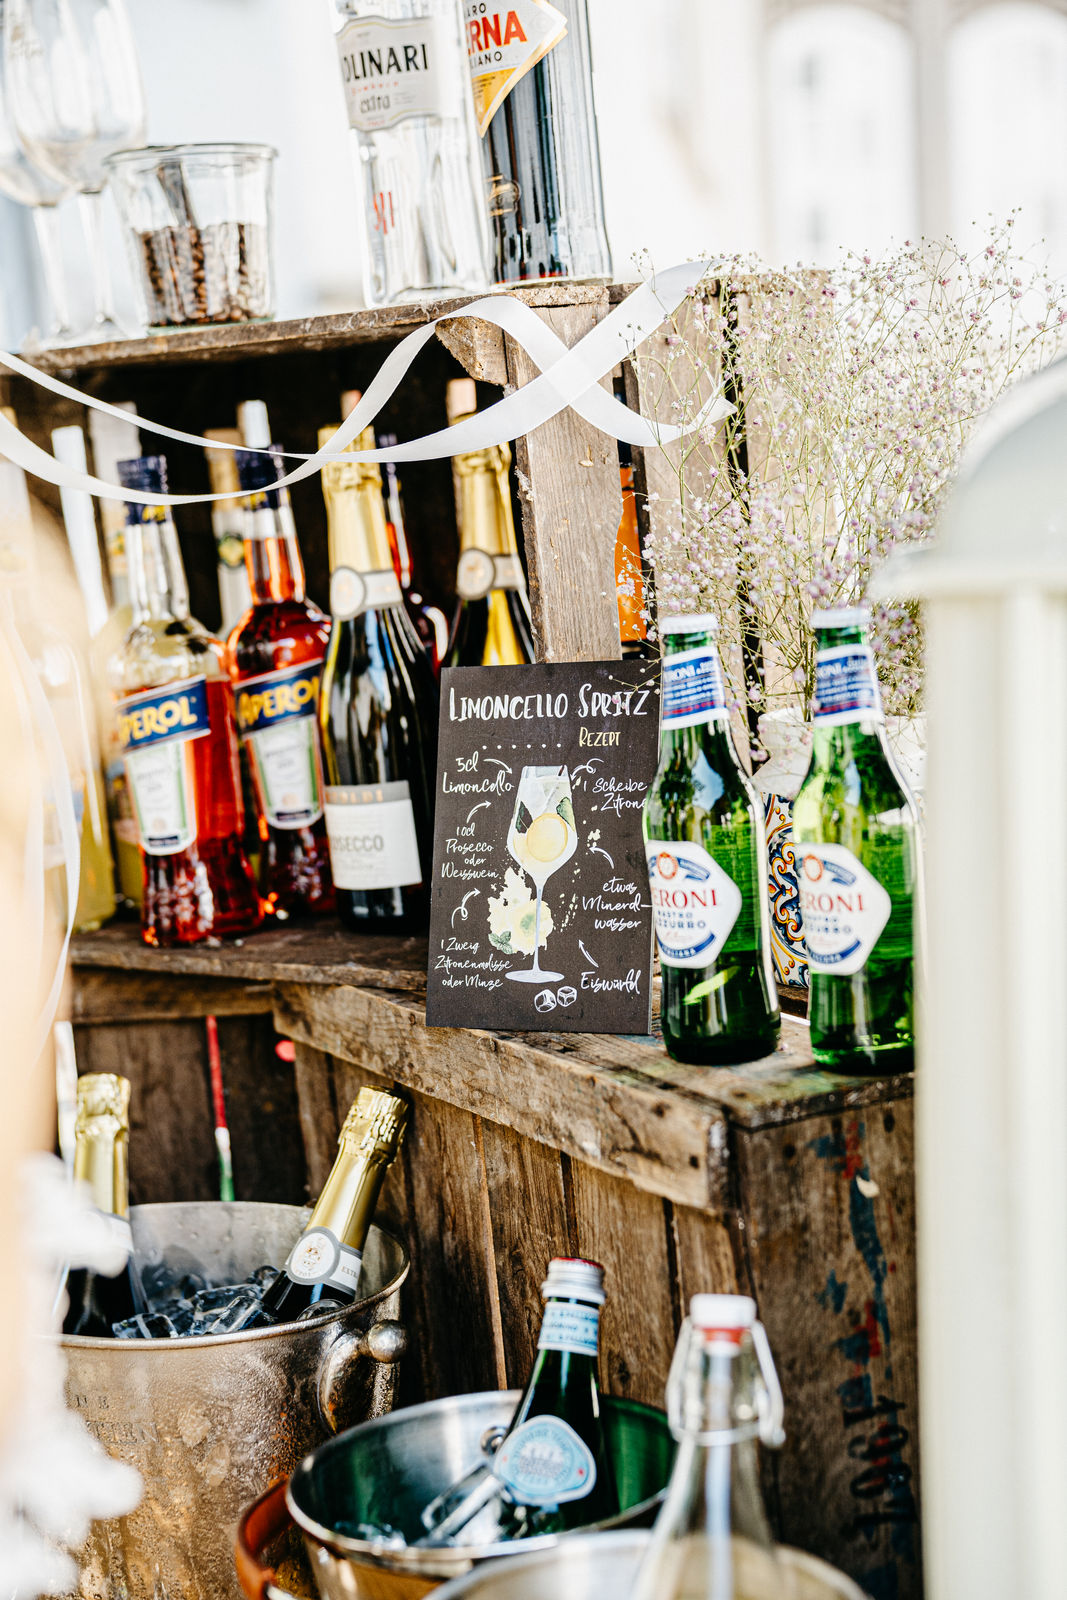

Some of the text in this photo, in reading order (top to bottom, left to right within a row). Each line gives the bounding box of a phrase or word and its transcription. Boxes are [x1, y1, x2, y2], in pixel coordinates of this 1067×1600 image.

[449, 687, 569, 722] LIMONCELLO
[577, 683, 650, 718] SPRITZ
[578, 727, 621, 747] REZEPT
[456, 751, 479, 773] 5cl
[442, 770, 515, 796] Limoncello
[592, 777, 648, 794] Scheibe
[445, 838, 494, 855] Prosecco
[464, 853, 487, 867] oder
[441, 861, 499, 881] Weisswein
[602, 876, 638, 894] etwas
[594, 917, 642, 932] wasser
[445, 937, 480, 955] Zweig
[434, 953, 513, 975] Zitronenmelisse
[441, 974, 503, 991] oder Minze
[580, 968, 642, 995] Eiswürfel
